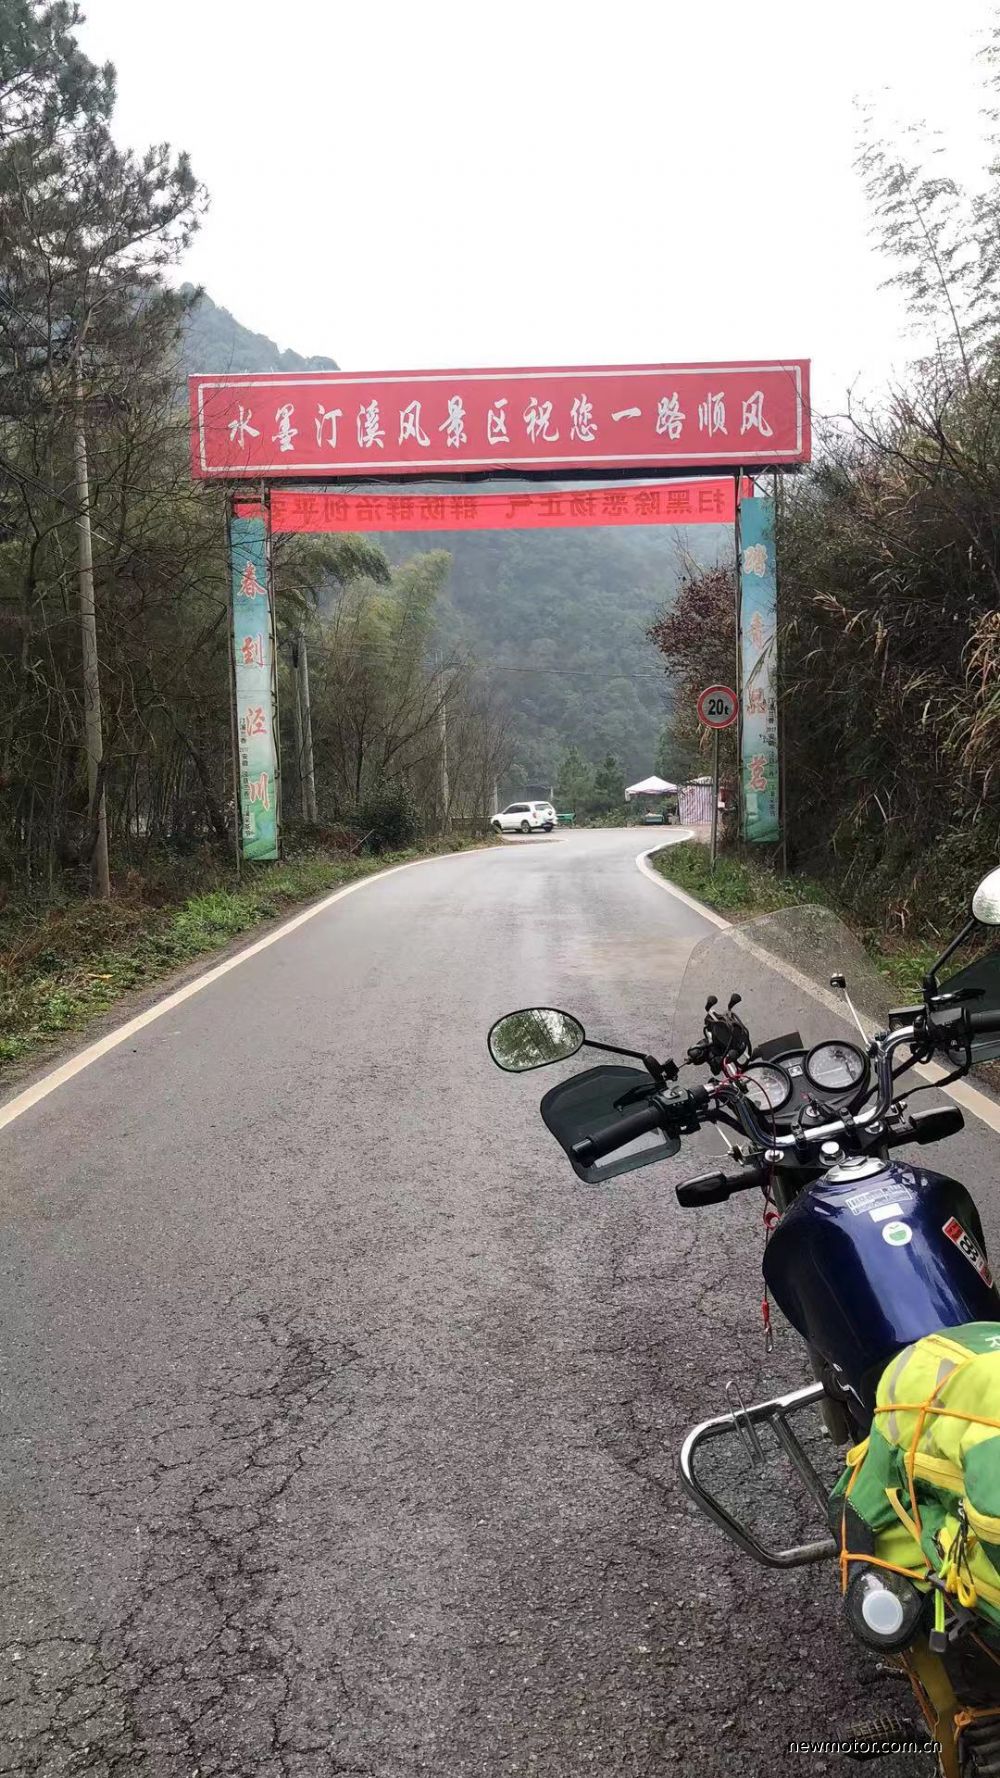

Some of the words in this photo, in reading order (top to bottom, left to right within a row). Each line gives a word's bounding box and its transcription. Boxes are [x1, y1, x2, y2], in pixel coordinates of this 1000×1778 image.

[228, 391, 773, 452] 水墨汀溪风景区祝您一路顺风
[708, 699, 729, 716] 20t
